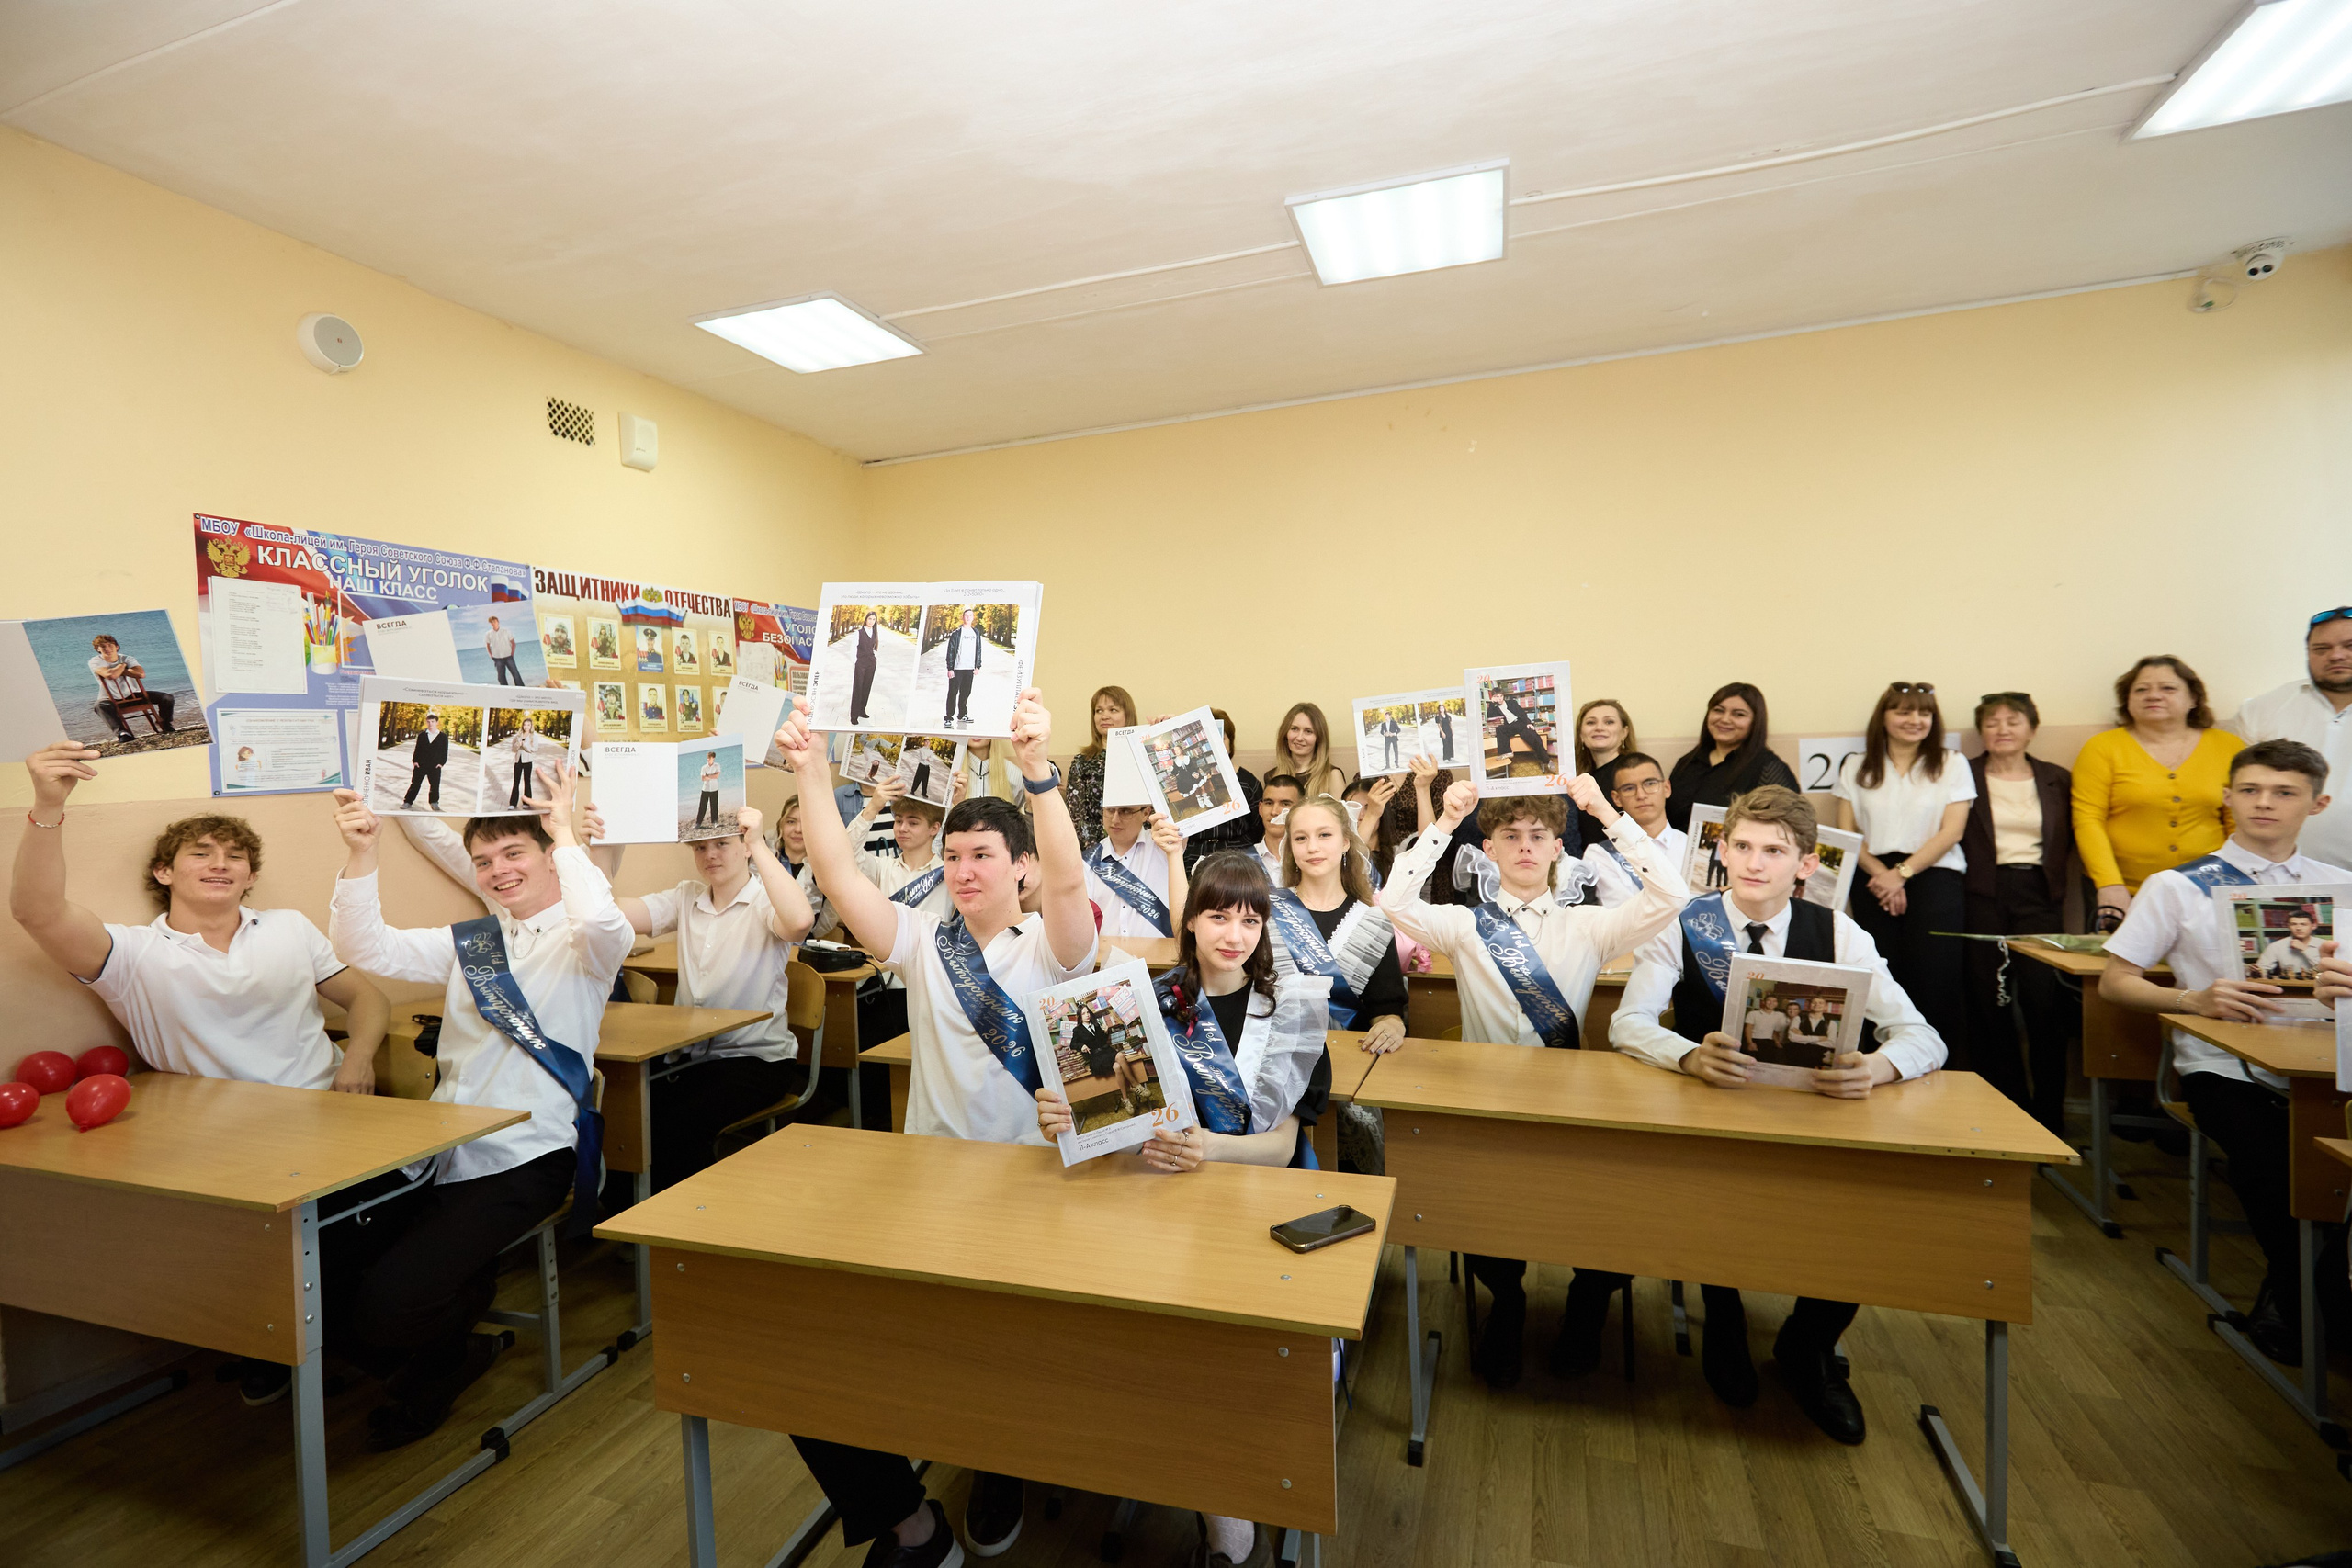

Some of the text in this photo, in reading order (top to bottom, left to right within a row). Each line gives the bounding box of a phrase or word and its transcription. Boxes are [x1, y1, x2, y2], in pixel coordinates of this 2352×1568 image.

[201, 517, 240, 536] МБОУ
[244, 525, 326, 547] «Школа-лицей
[329, 537, 347, 550] им.
[349, 540, 379, 557] Героя
[380, 545, 433, 564] Советского
[435, 553, 462, 568] Союза
[257, 545, 490, 593] КЛАССНЫЙ УГОЛОК
[329, 574, 437, 600] НАШ КЛАСС
[534, 570, 731, 618] ЗАЩИТНИКИ ОТЕЧЕСТВА
[376, 619, 406, 630] ВСЕГДА
[763, 632, 814, 647] БЕЗОПАС
[739, 681, 758, 691] ВСЕГДА
[1476, 673, 1490, 683] 20
[1544, 773, 1567, 787] 26
[1223, 798, 1240, 815] 26
[1137, 904, 1160, 919] 2026
[937, 935, 1024, 1024] Выпускник
[1747, 971, 1764, 980] 20
[463, 965, 546, 1049] Выпускник
[1039, 996, 1055, 1011] 20
[982, 1028, 1026, 1058] 2026
[1151, 1102, 1179, 1127] 26
[1091, 1137, 1109, 1148] класс
